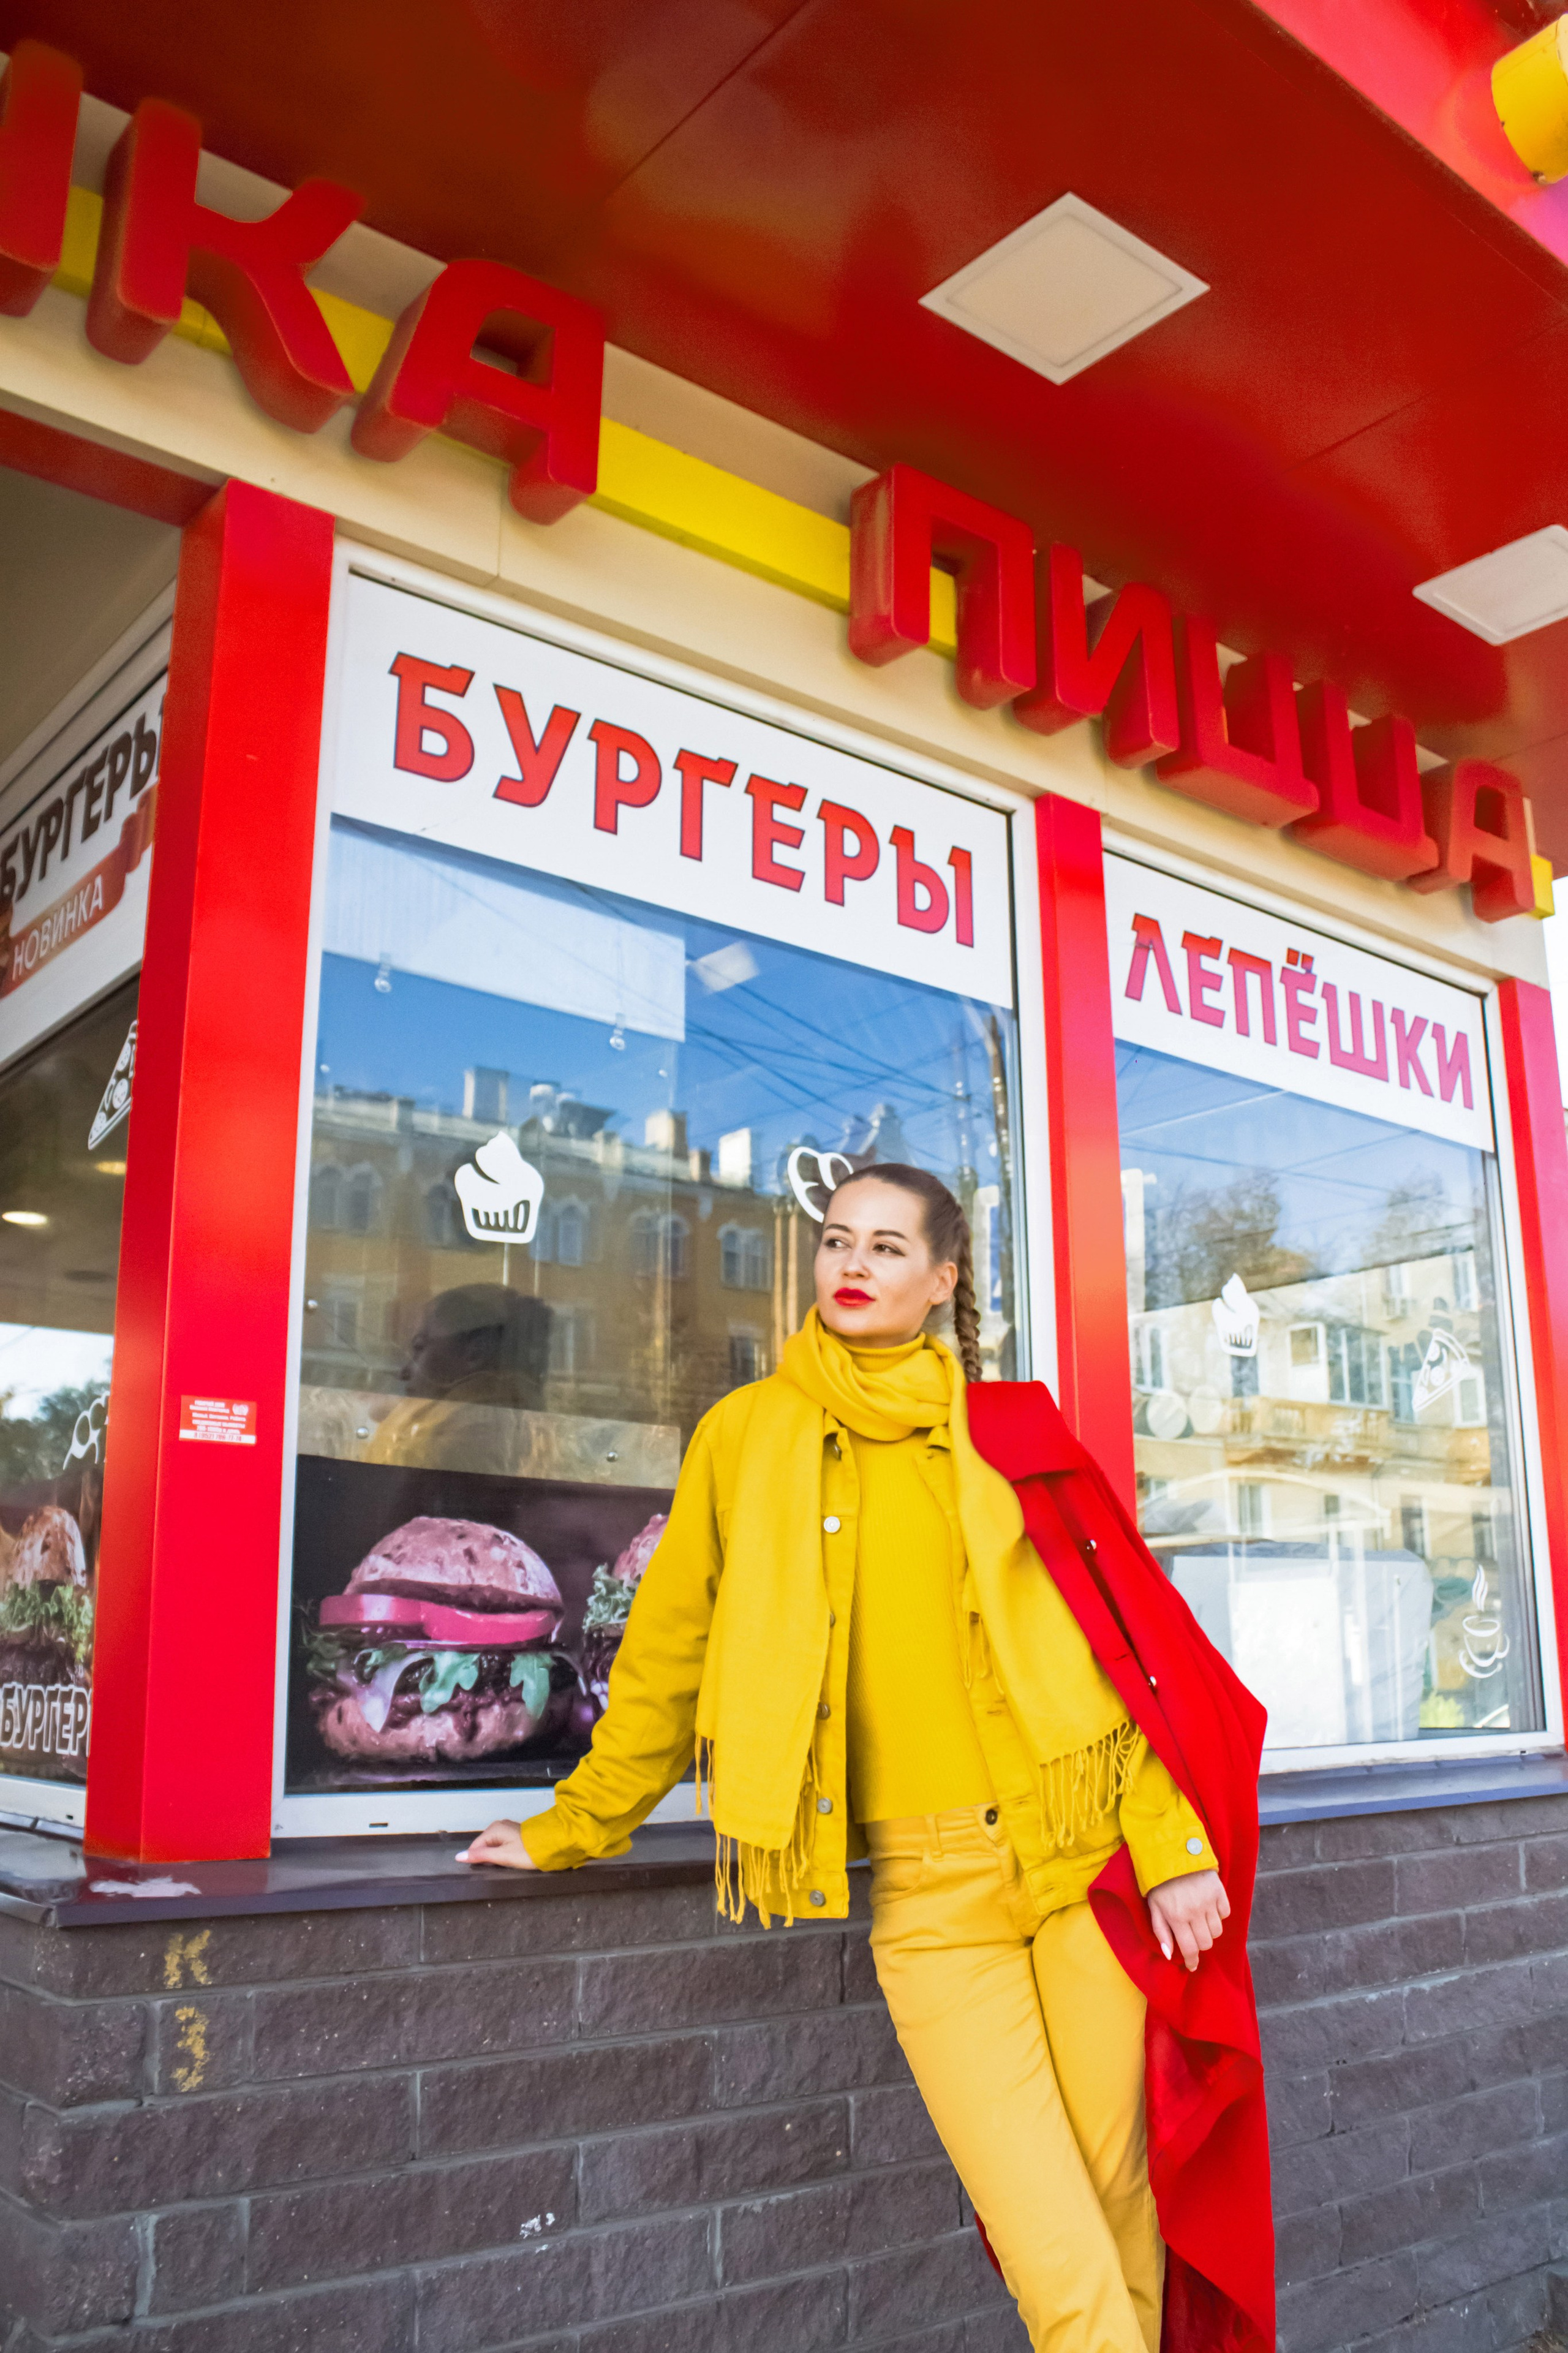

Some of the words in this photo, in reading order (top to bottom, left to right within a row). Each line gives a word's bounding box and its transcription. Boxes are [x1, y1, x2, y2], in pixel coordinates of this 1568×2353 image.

[849, 463, 1536, 923] ПИЦЦА
[388, 651, 974, 948] БУРГЕРЫ
[12, 874, 103, 981] НОВИНКА
[1125, 913, 1474, 1111] ЛЕПЁШКИ
[0, 1682, 92, 1757] БУРГЕР
